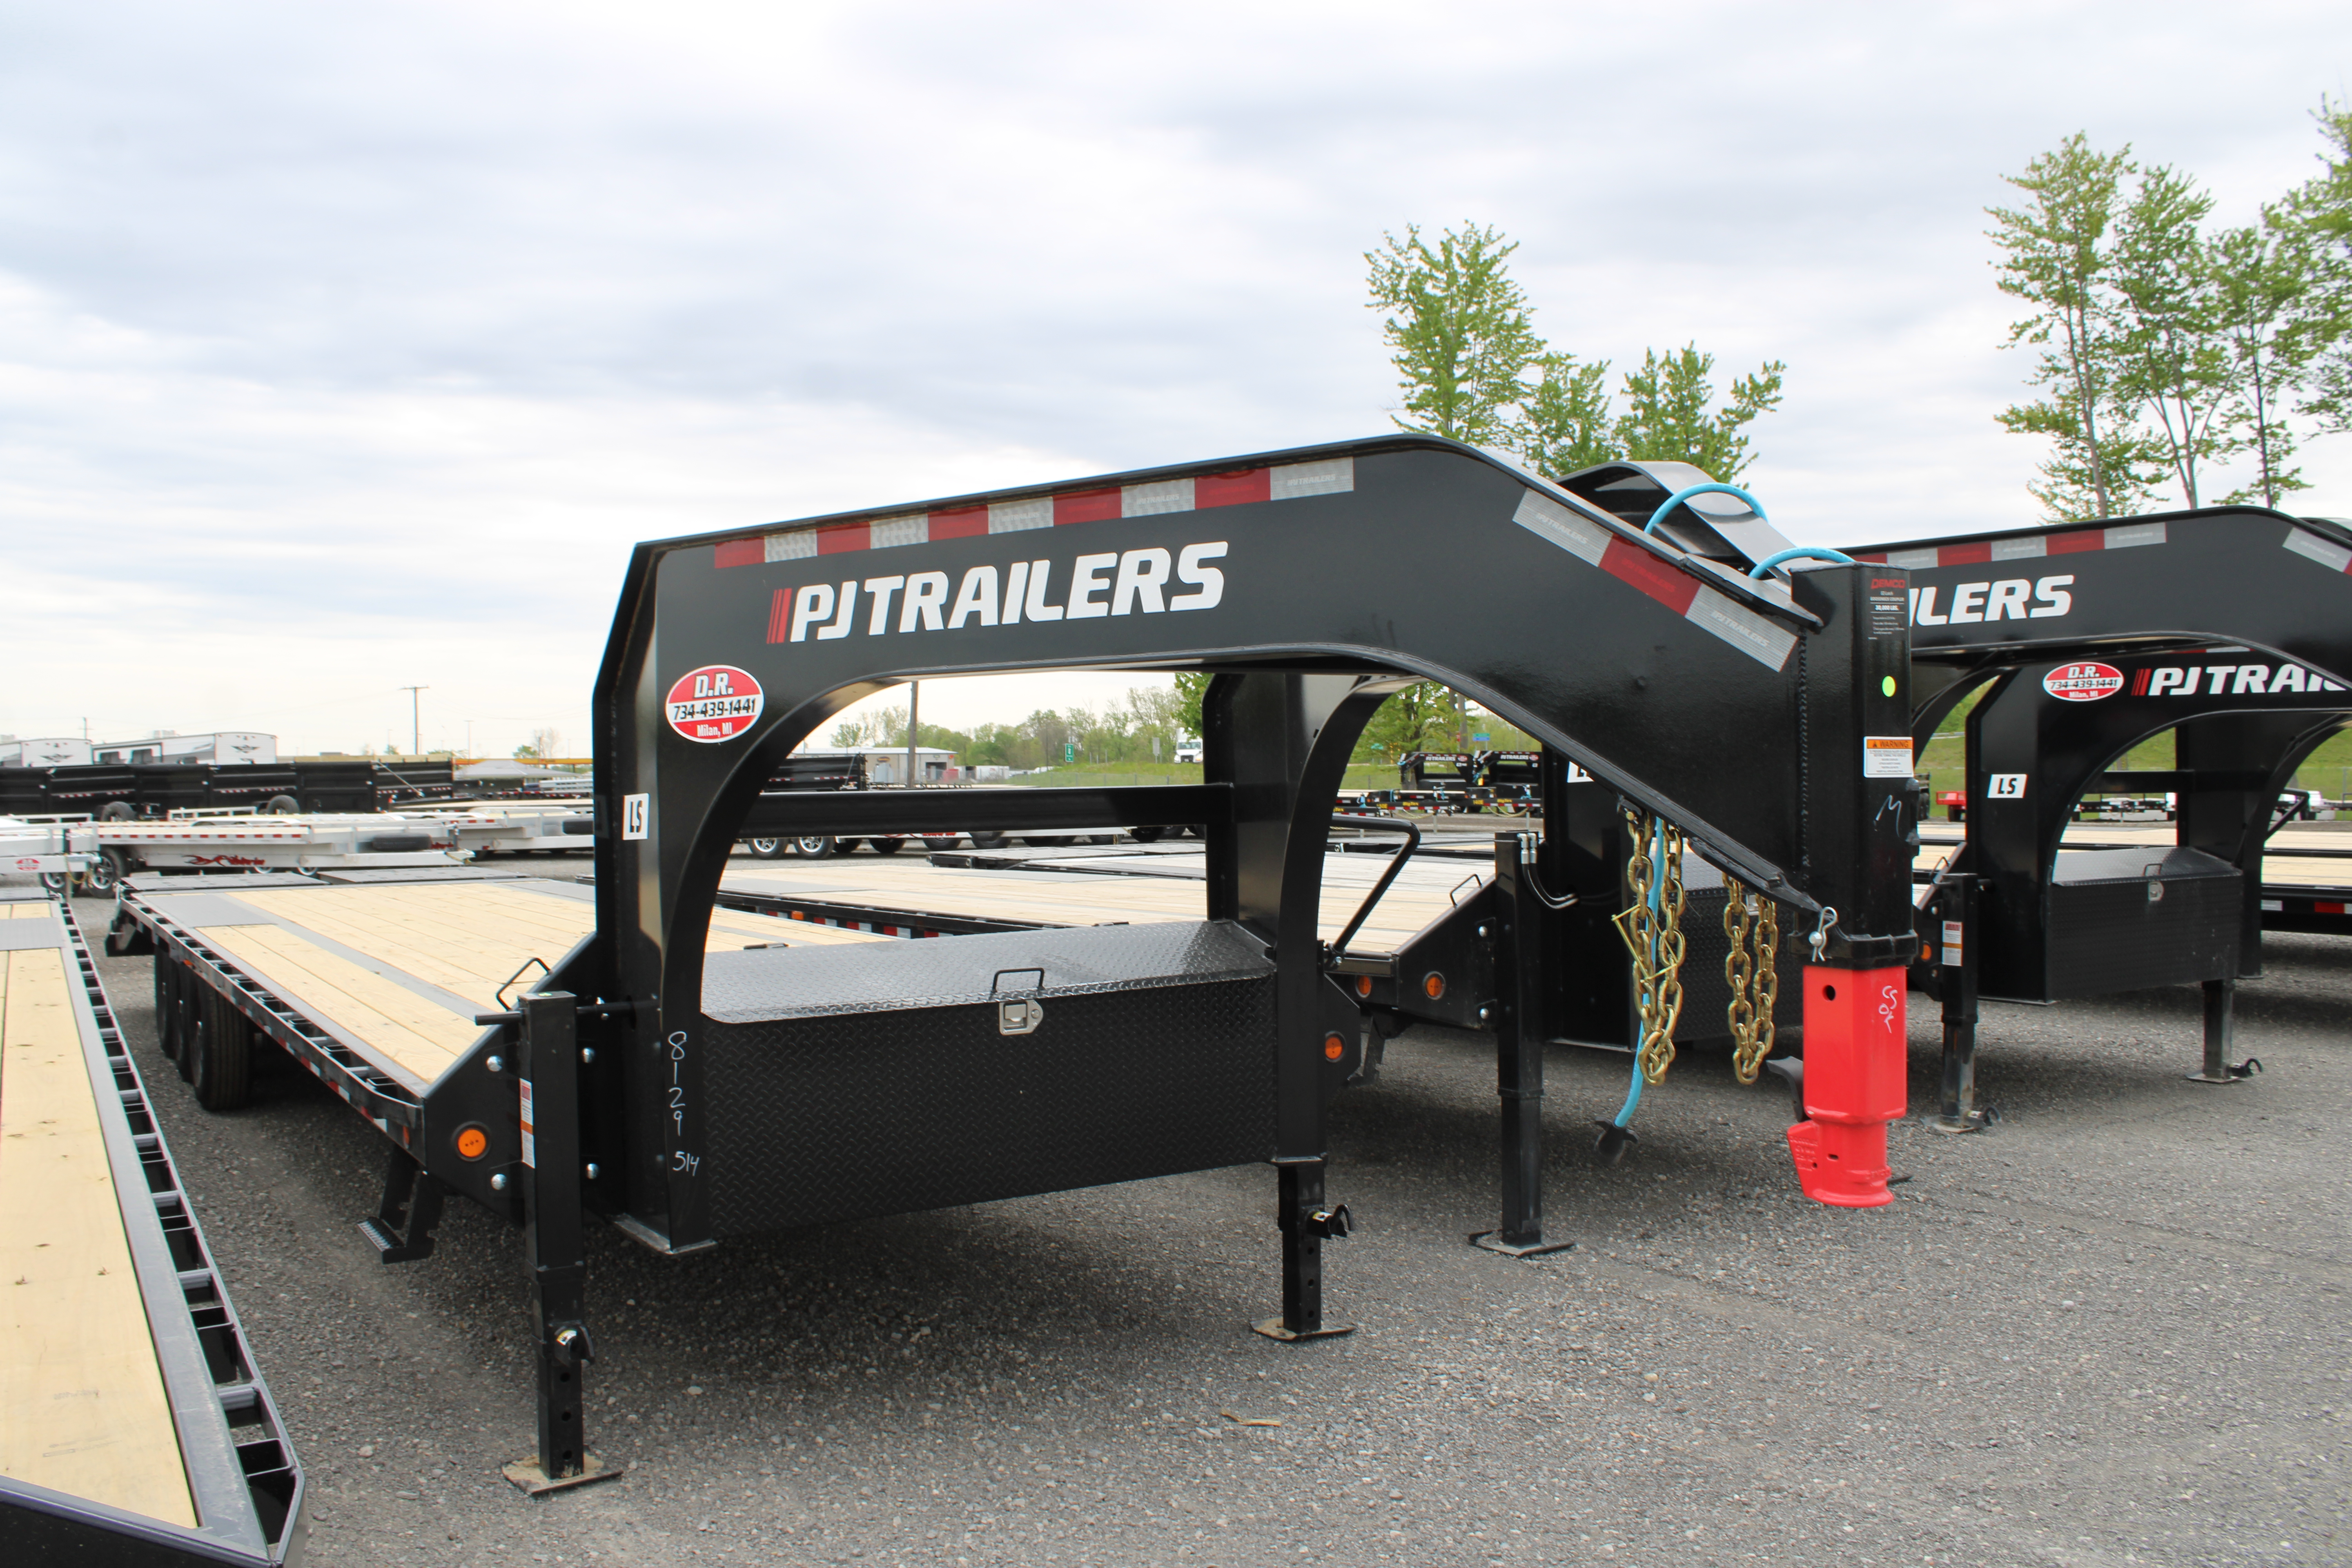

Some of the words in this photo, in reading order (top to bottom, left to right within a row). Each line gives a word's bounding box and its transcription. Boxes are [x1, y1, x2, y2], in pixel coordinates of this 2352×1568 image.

[864, 541, 1228, 635] TRAILERS
[1871, 579, 1906, 589] DEMCO
[2067, 665, 2101, 679] D.R.
[693, 672, 734, 699] D.R.
[2050, 679, 2118, 690] 734-439-1441
[673, 697, 757, 720] 734-439-1441
[697, 724, 721, 738] Milan,
[722, 722, 733, 735] MI
[1997, 777, 2018, 795] LS
[629, 800, 643, 833] LS
